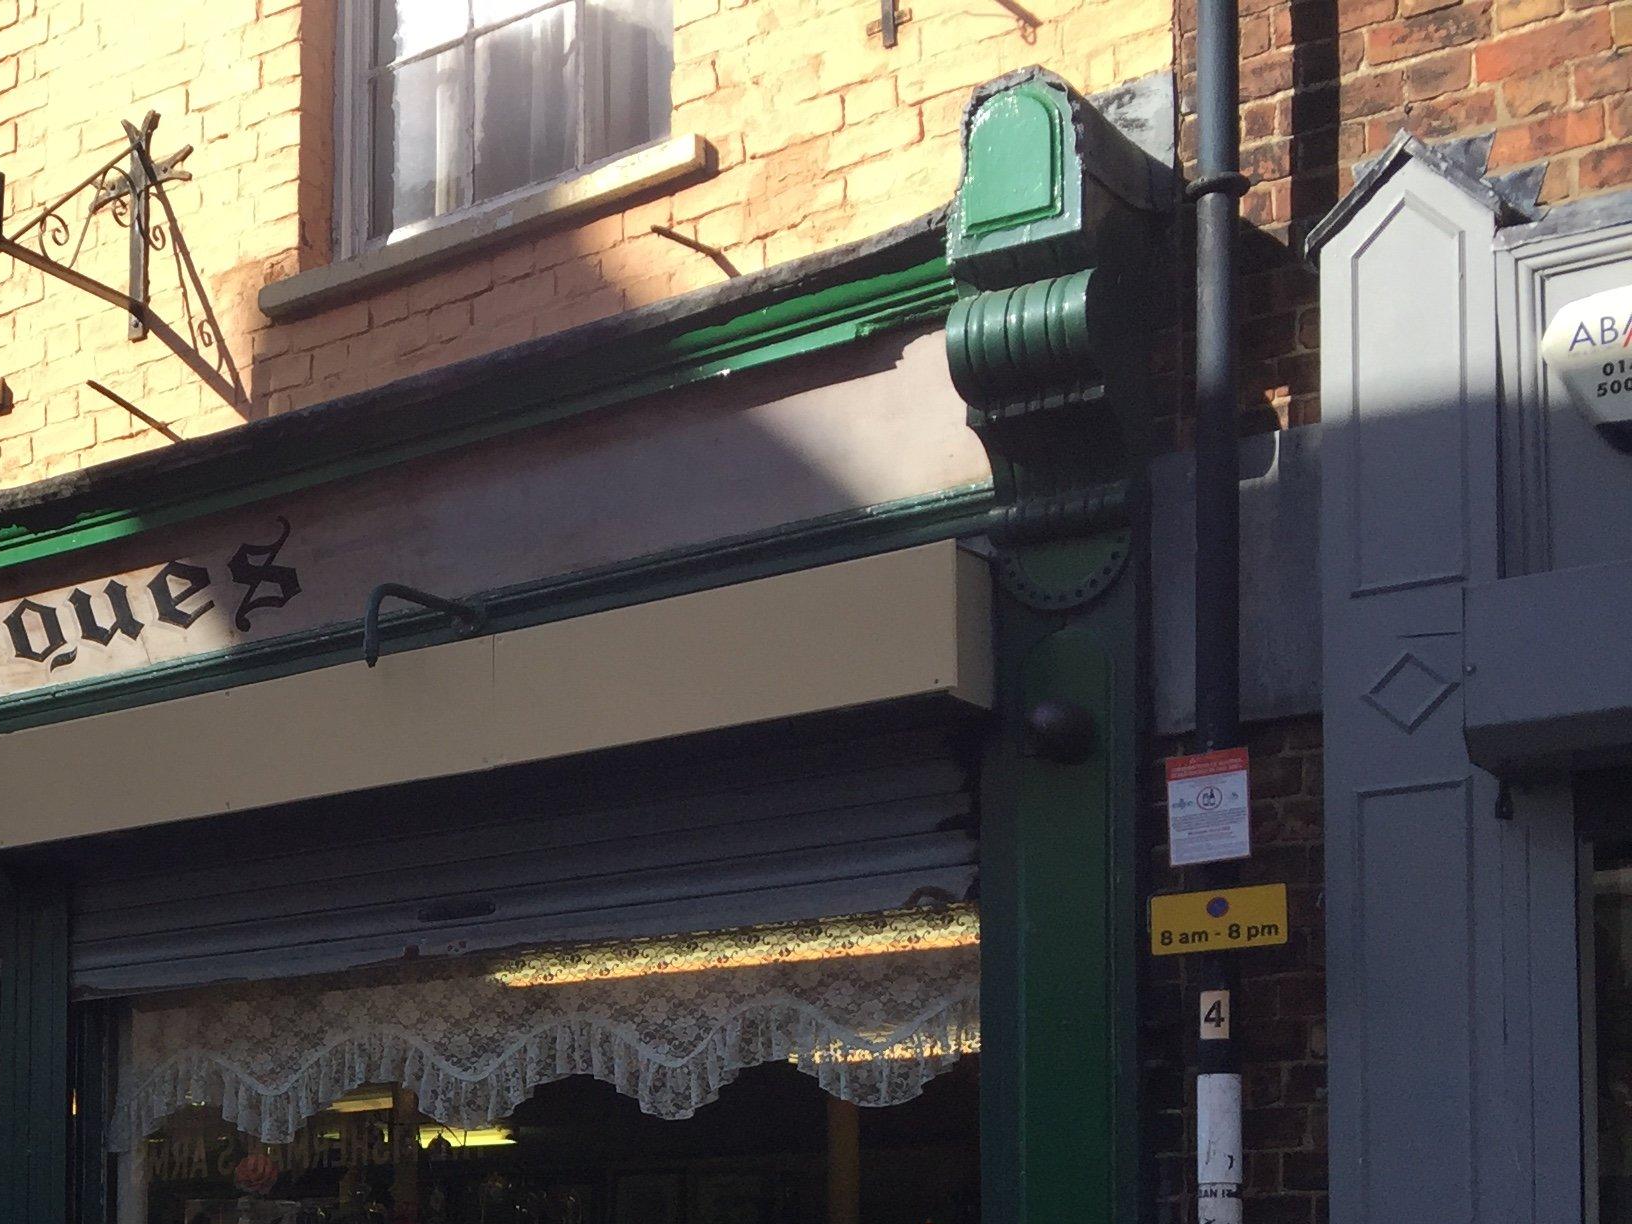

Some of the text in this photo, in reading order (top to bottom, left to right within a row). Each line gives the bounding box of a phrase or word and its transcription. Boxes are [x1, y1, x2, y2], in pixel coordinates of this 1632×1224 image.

[1602, 359, 1632, 376] 01
[1160, 930, 1173, 946] 8
[1179, 930, 1209, 944] am
[1228, 923, 1241, 940] 8
[1247, 923, 1279, 942] pm
[1204, 1000, 1225, 1028] 4
